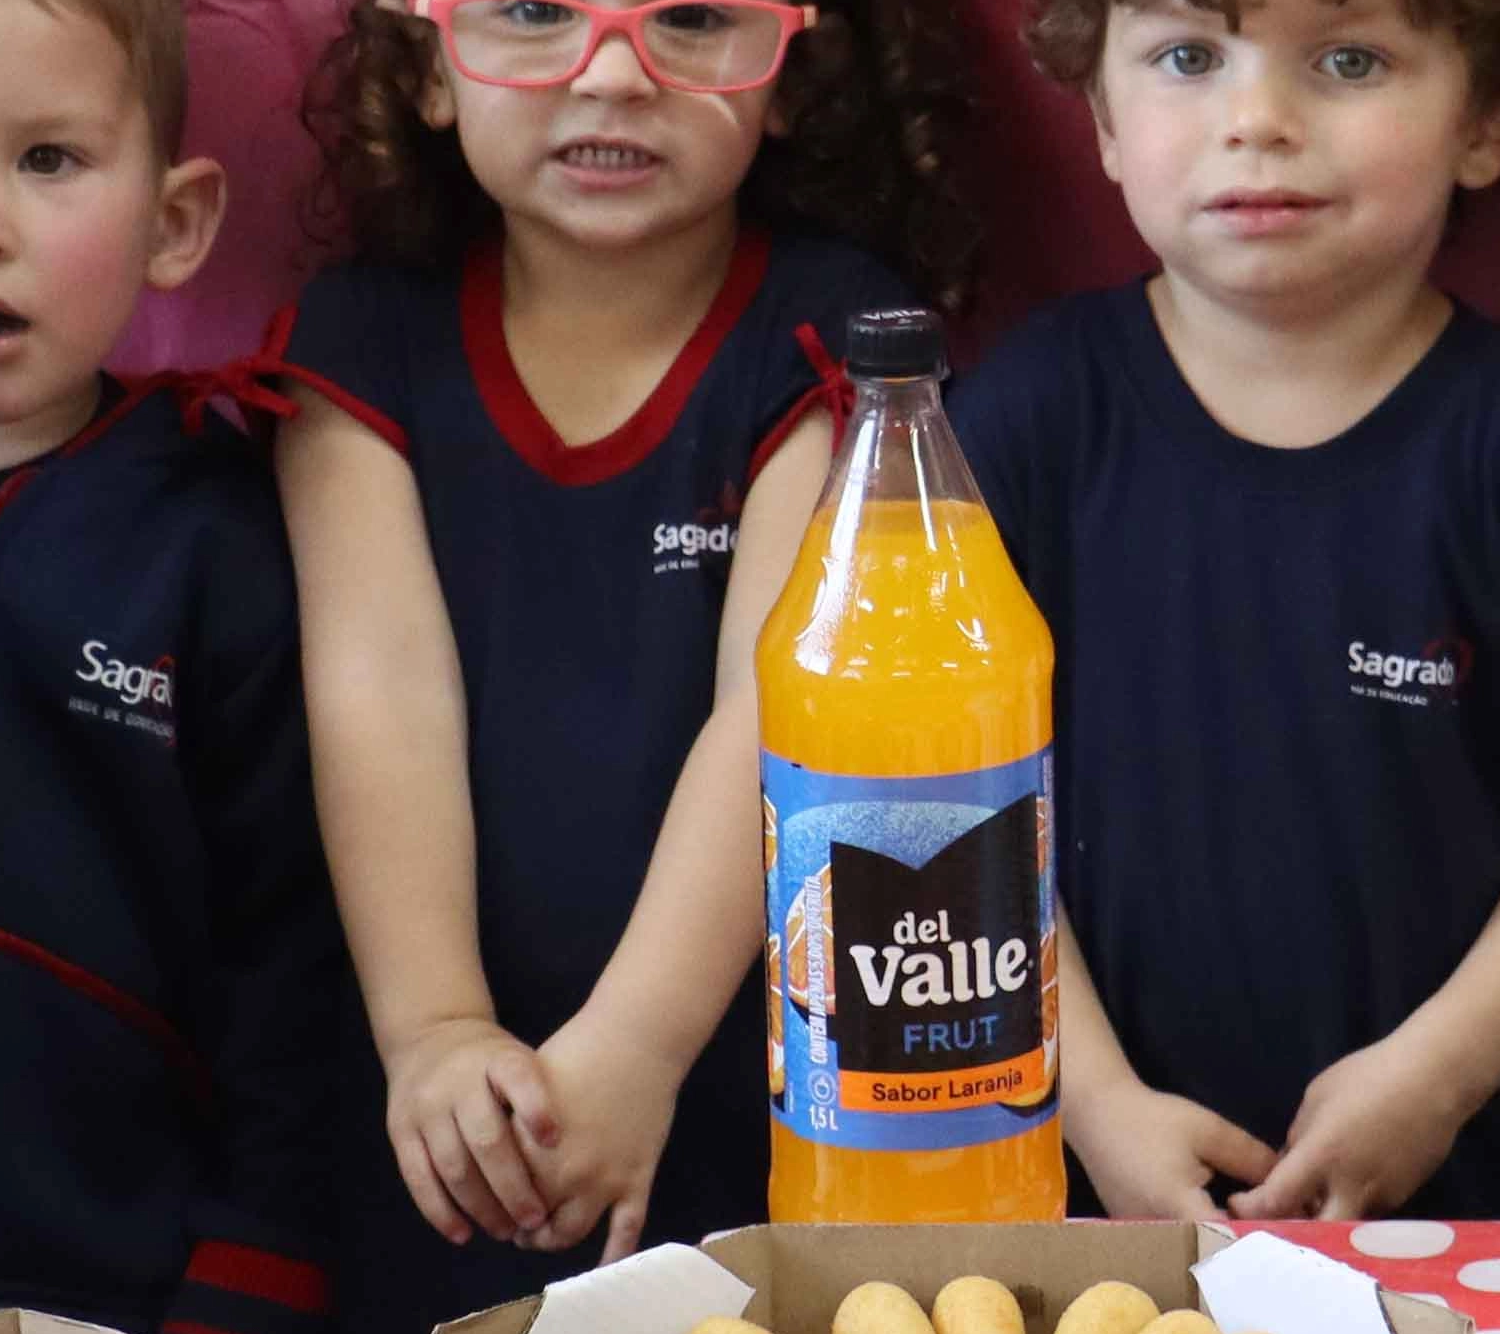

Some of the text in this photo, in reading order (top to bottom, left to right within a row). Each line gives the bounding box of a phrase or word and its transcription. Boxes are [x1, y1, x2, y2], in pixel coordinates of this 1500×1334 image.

[892, 908, 949, 946] del
[848, 935, 1029, 1007] Valle
[903, 1014, 1001, 1054] FRUT
[872, 1069, 1023, 1104] Sabor Laranja
